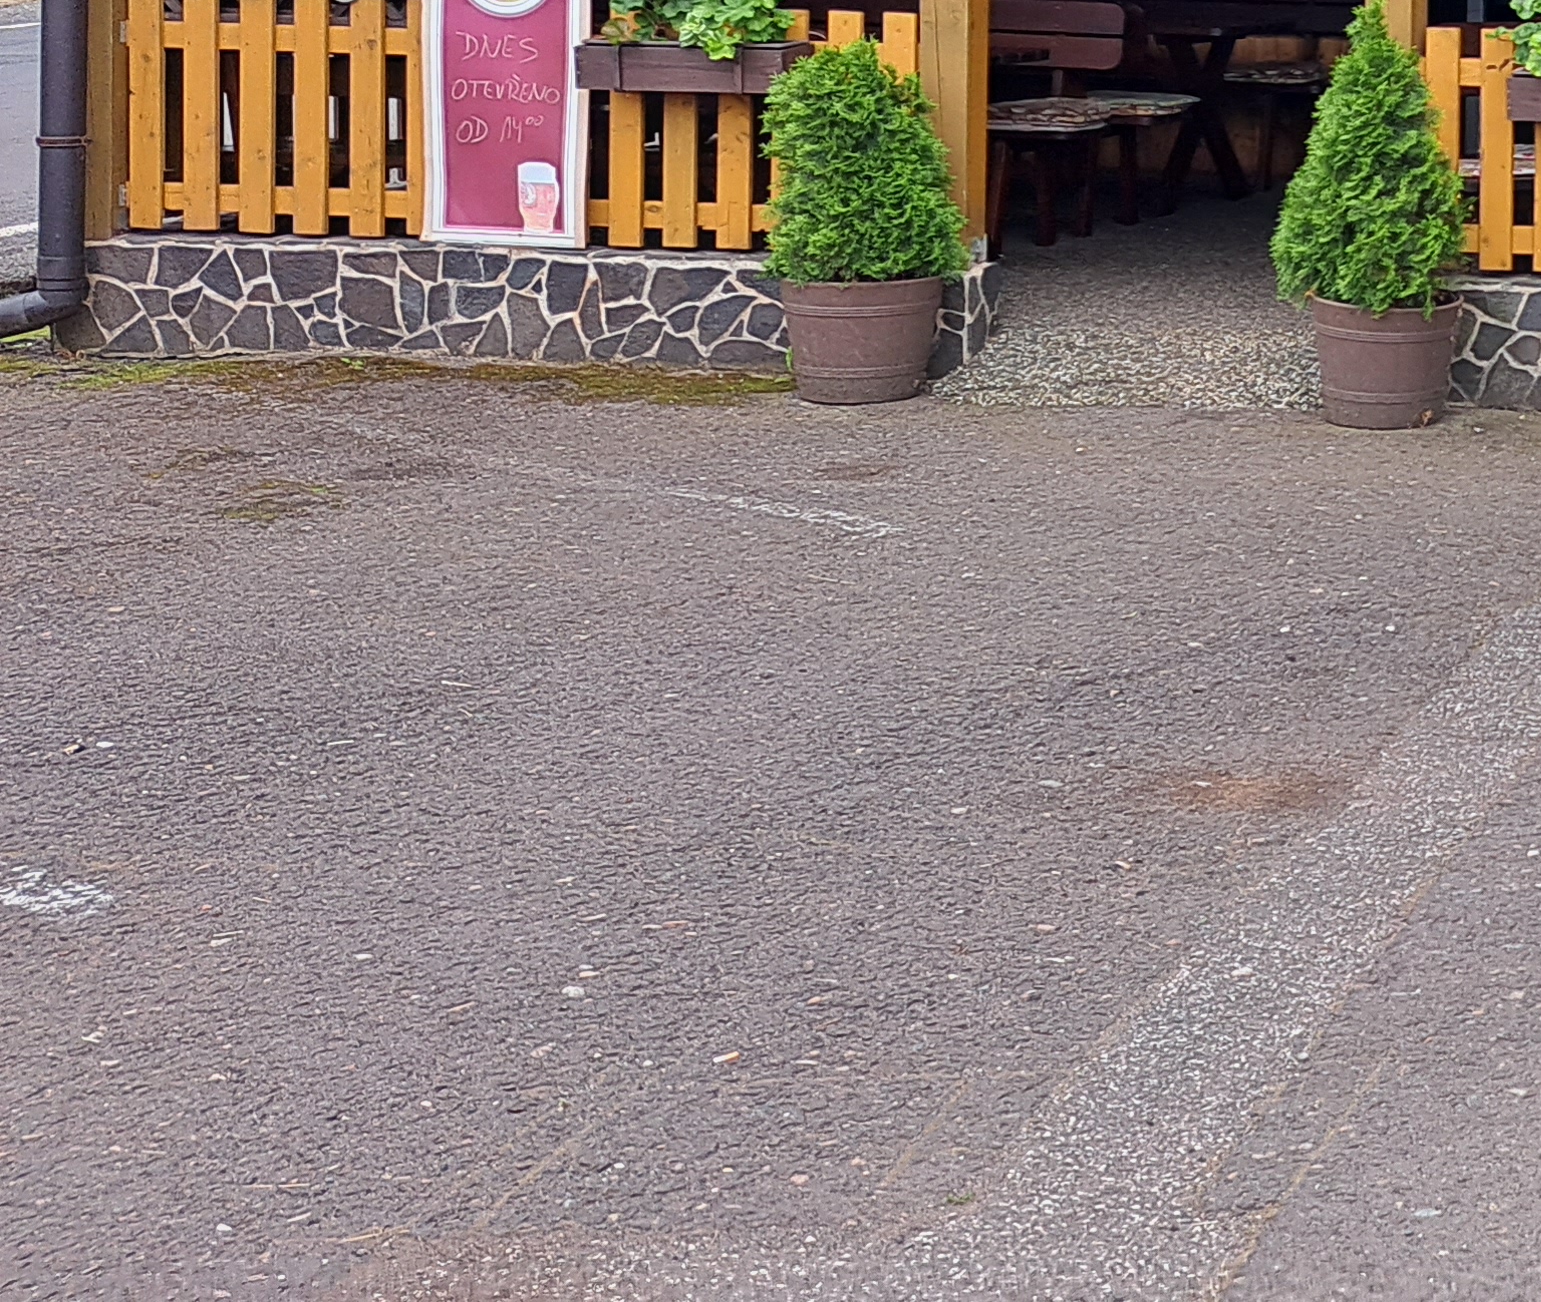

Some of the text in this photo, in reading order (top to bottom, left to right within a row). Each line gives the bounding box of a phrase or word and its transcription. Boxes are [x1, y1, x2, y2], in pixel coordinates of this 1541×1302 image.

[456, 31, 538, 63] DNES
[451, 74, 561, 104] OTEVŘENO
[456, 116, 488, 143] OD
